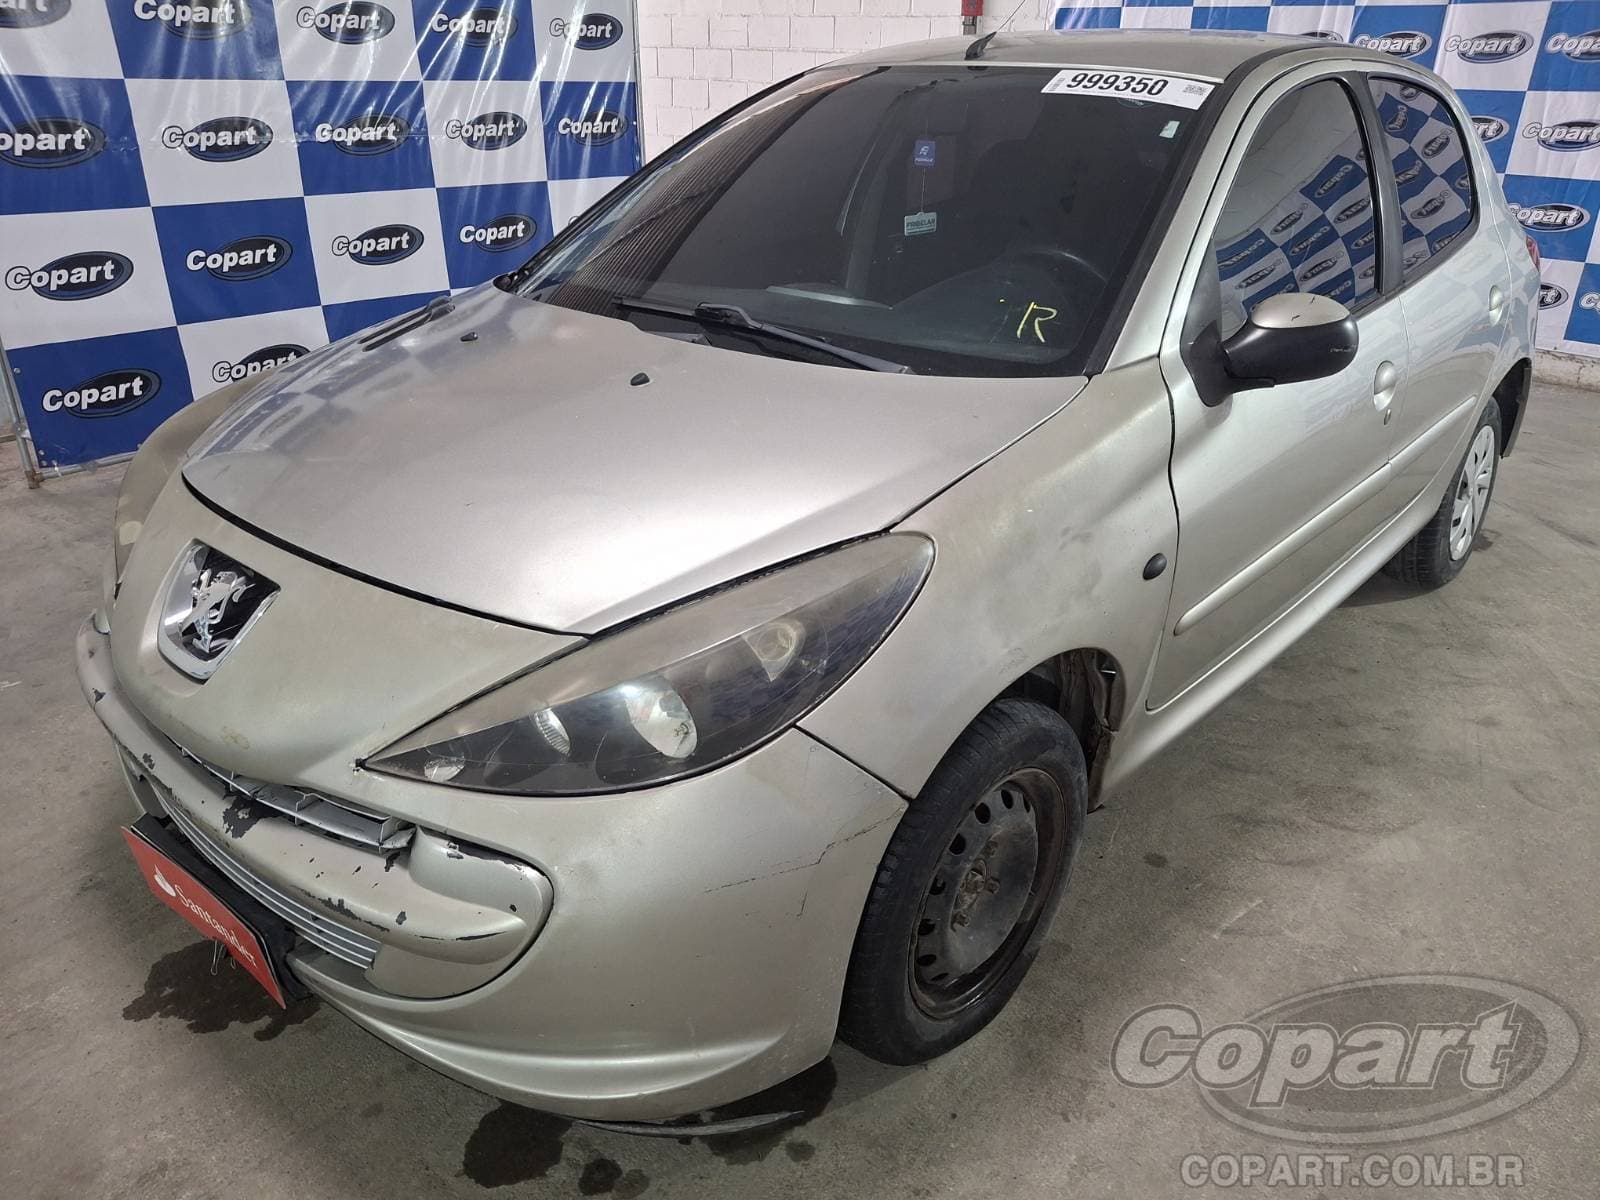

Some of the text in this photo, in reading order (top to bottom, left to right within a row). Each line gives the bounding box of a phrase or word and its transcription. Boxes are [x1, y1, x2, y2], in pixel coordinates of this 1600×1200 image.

[134, 0, 235, 26] Copart
[298, 8, 380, 29] Copart
[432, 14, 506, 37] Copart
[550, 18, 613, 41] Copart
[1355, 34, 1424, 51] Copart
[1446, 34, 1521, 54] Copart
[1067, 73, 1169, 96] 999350
[316, 121, 397, 143] Copart
[446, 119, 516, 140] Copart
[558, 117, 619, 135] Copart
[162, 126, 257, 151] Copart
[1507, 203, 1579, 225] Copart
[332, 232, 410, 256] Copart
[459, 221, 525, 244] Copart
[186, 243, 277, 272] Copart
[6, 260, 115, 290] Copart
[42, 376, 144, 412] Copart
[174, 885, 257, 968] Santander
